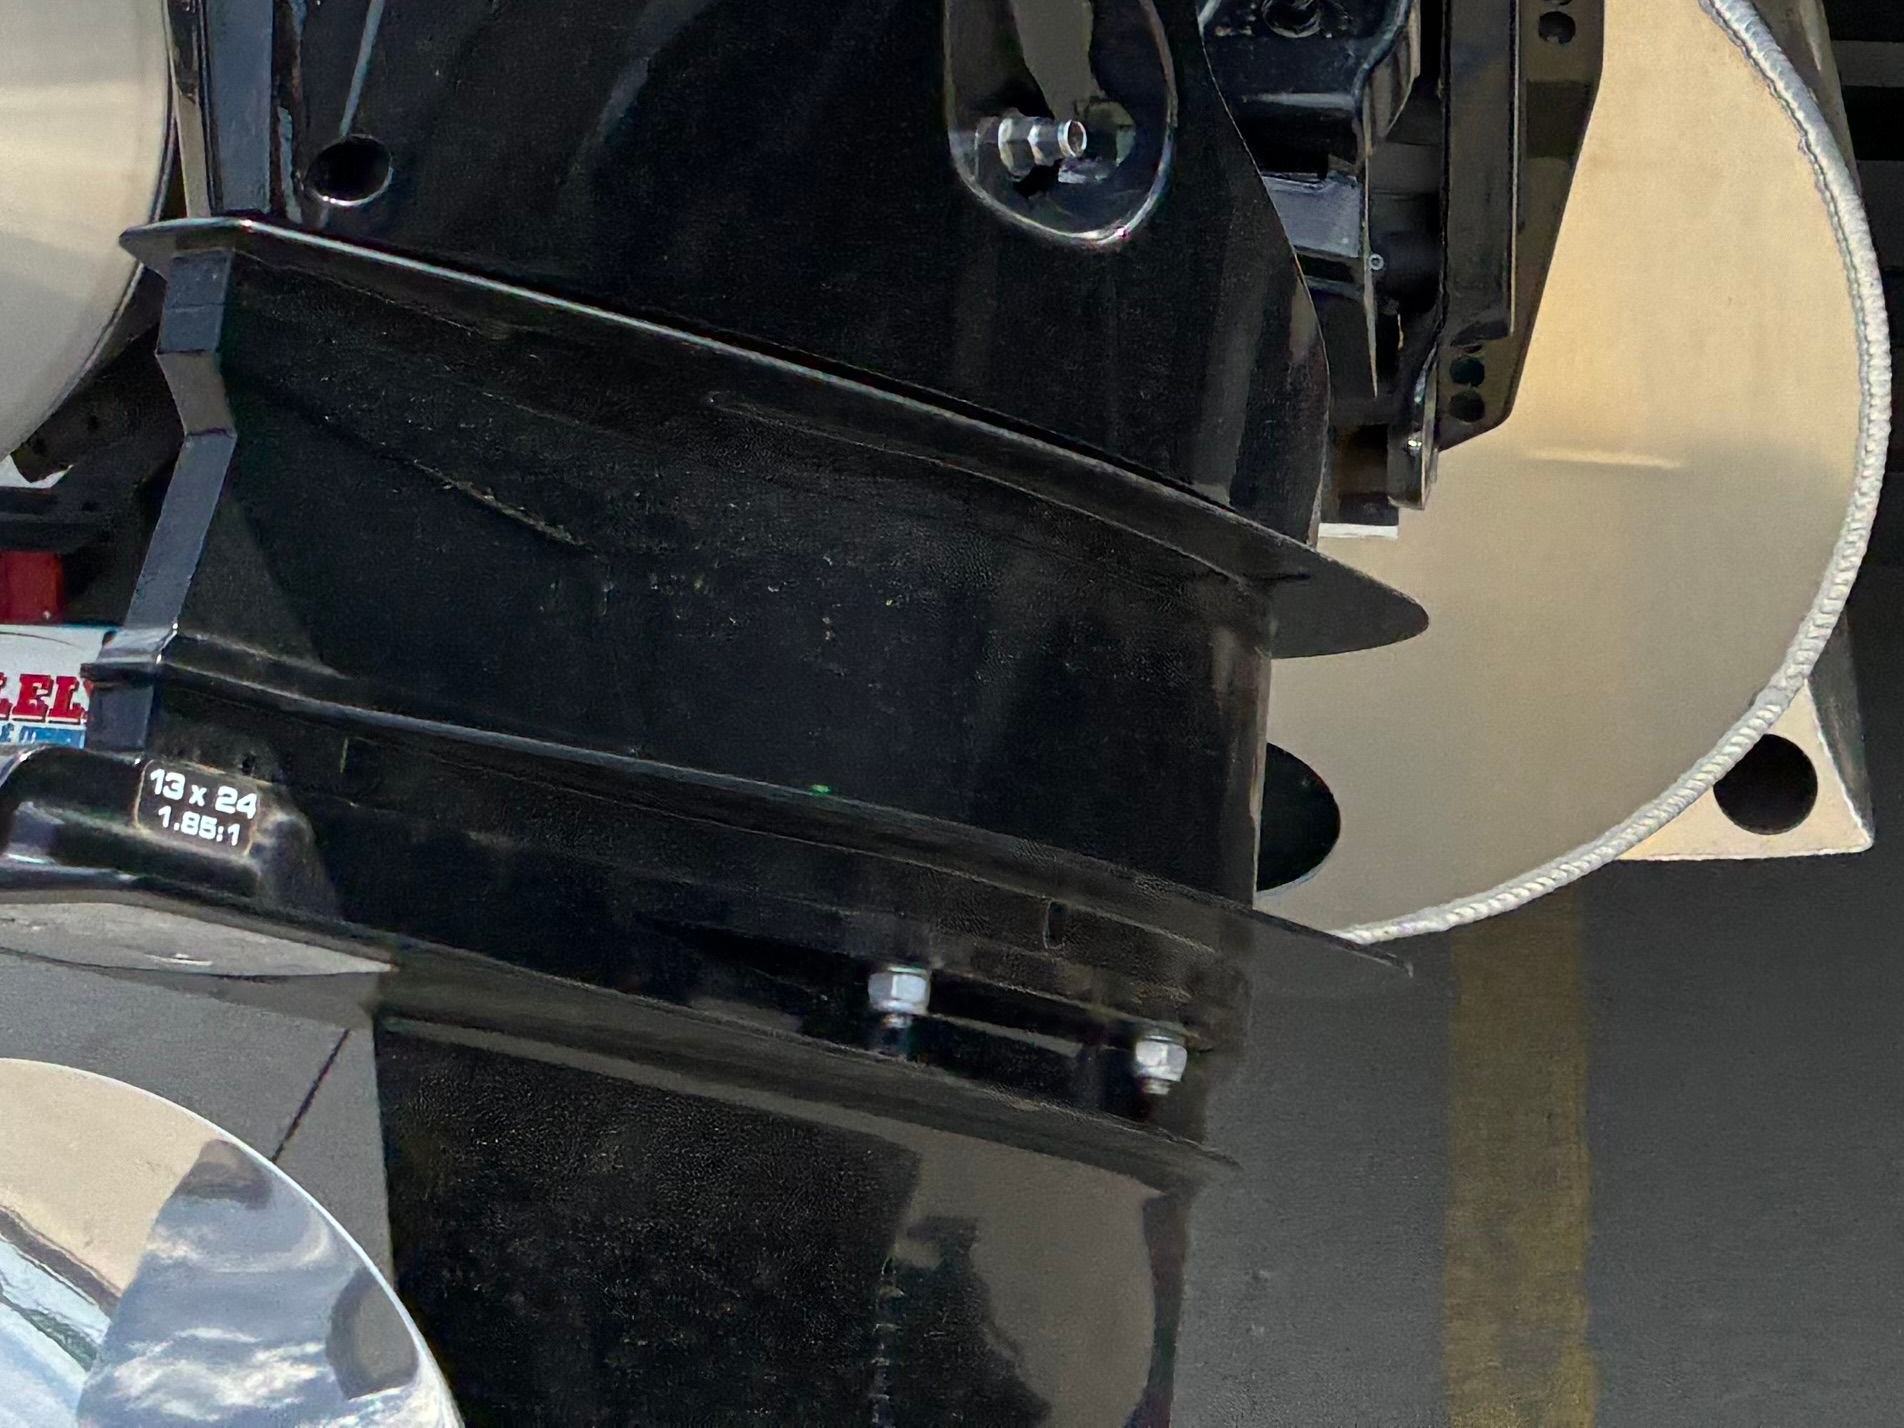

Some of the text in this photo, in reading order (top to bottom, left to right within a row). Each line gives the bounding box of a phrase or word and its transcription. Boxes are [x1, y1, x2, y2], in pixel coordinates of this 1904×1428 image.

[149, 767, 258, 820] 13 x 24
[157, 804, 241, 847] 1.85:1
